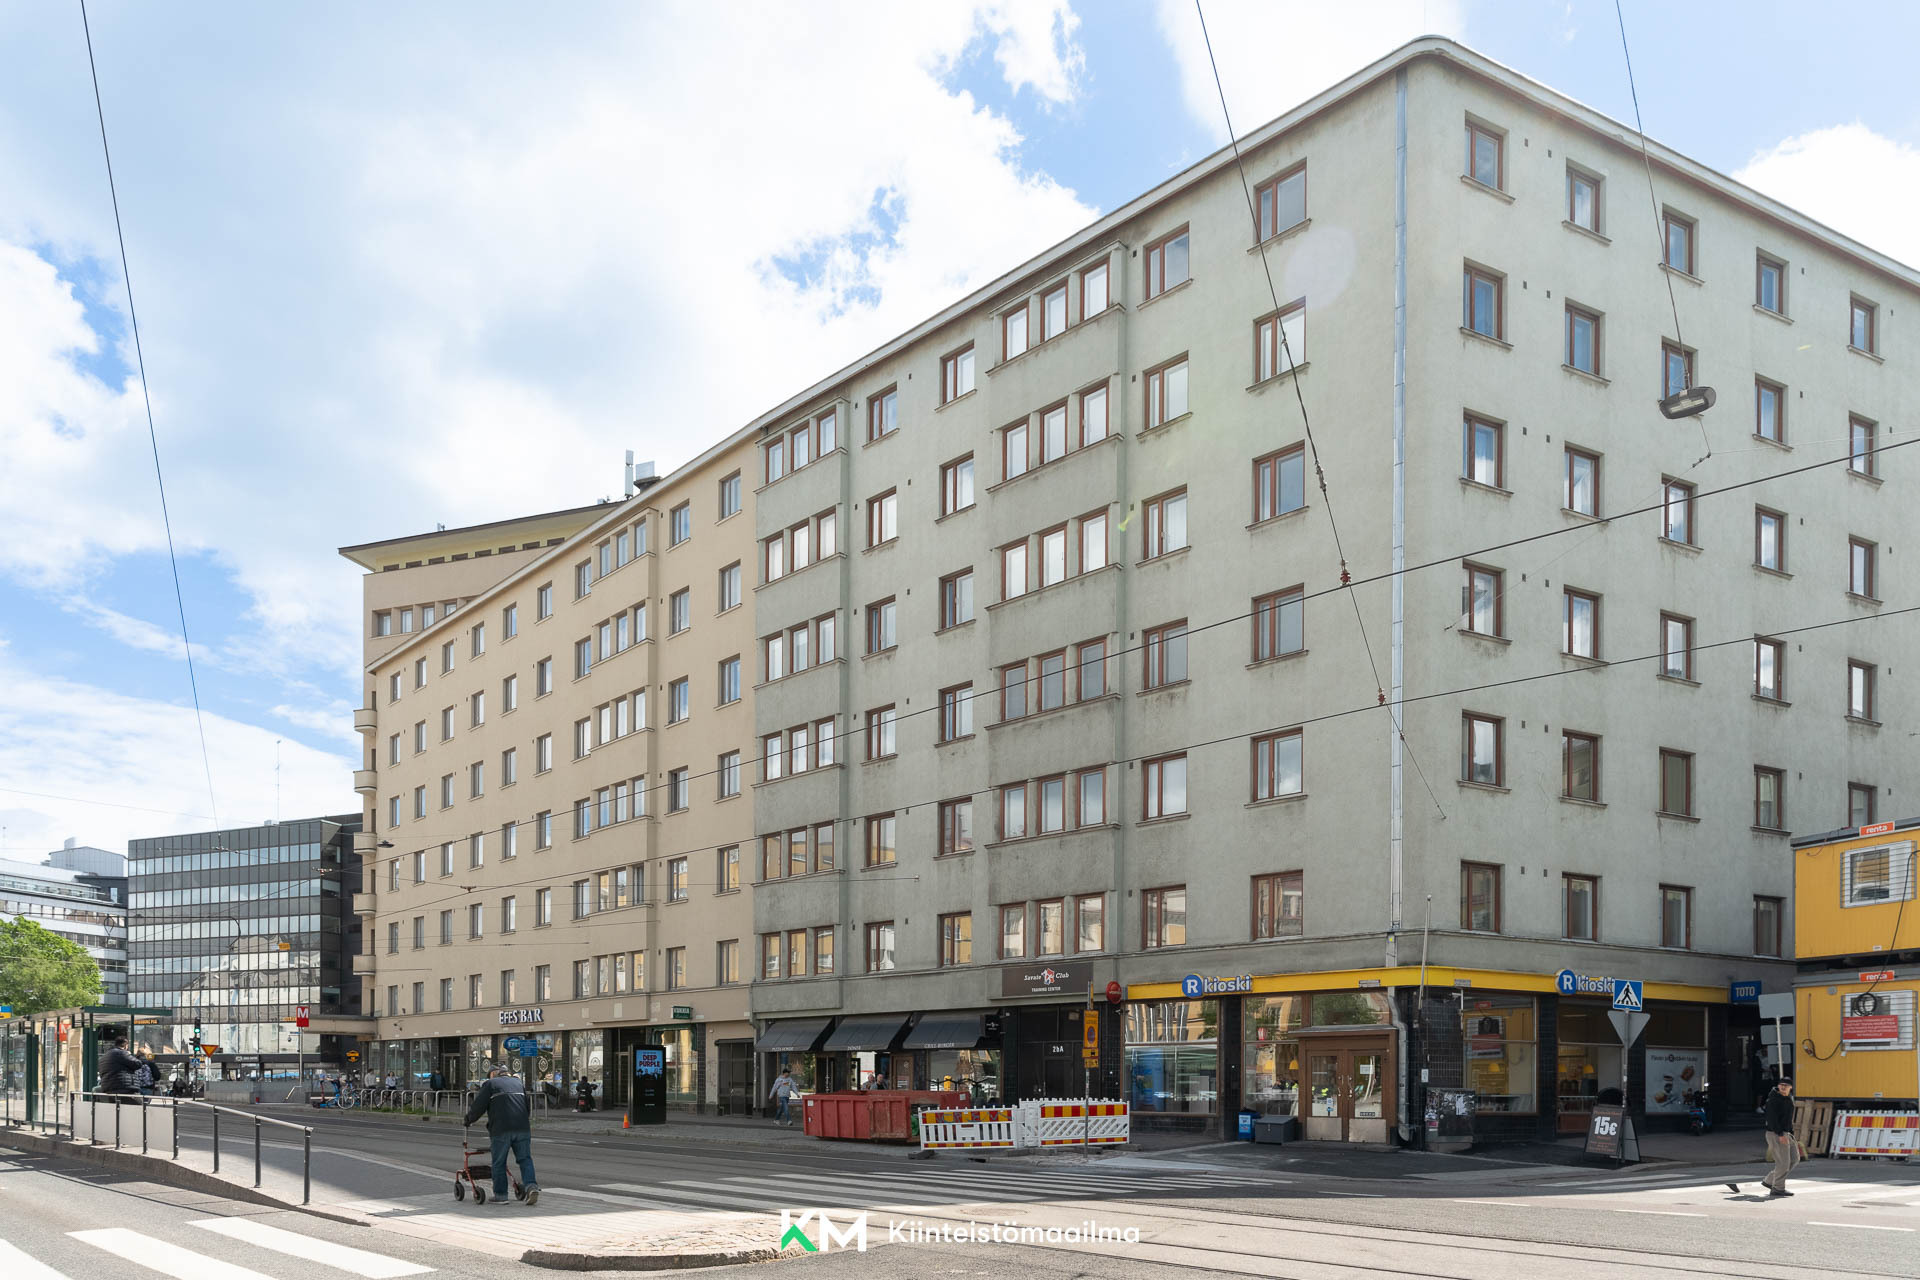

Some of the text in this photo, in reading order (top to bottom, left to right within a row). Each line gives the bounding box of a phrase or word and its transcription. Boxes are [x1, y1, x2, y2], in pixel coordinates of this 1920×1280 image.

[1866, 825, 1888, 834] renta
[1203, 975, 1251, 993] kioski
[1735, 985, 1756, 998] TOTO
[297, 1007, 309, 1019] M
[498, 1008, 543, 1025] EFES BAR
[1594, 1116, 1618, 1136] 15€
